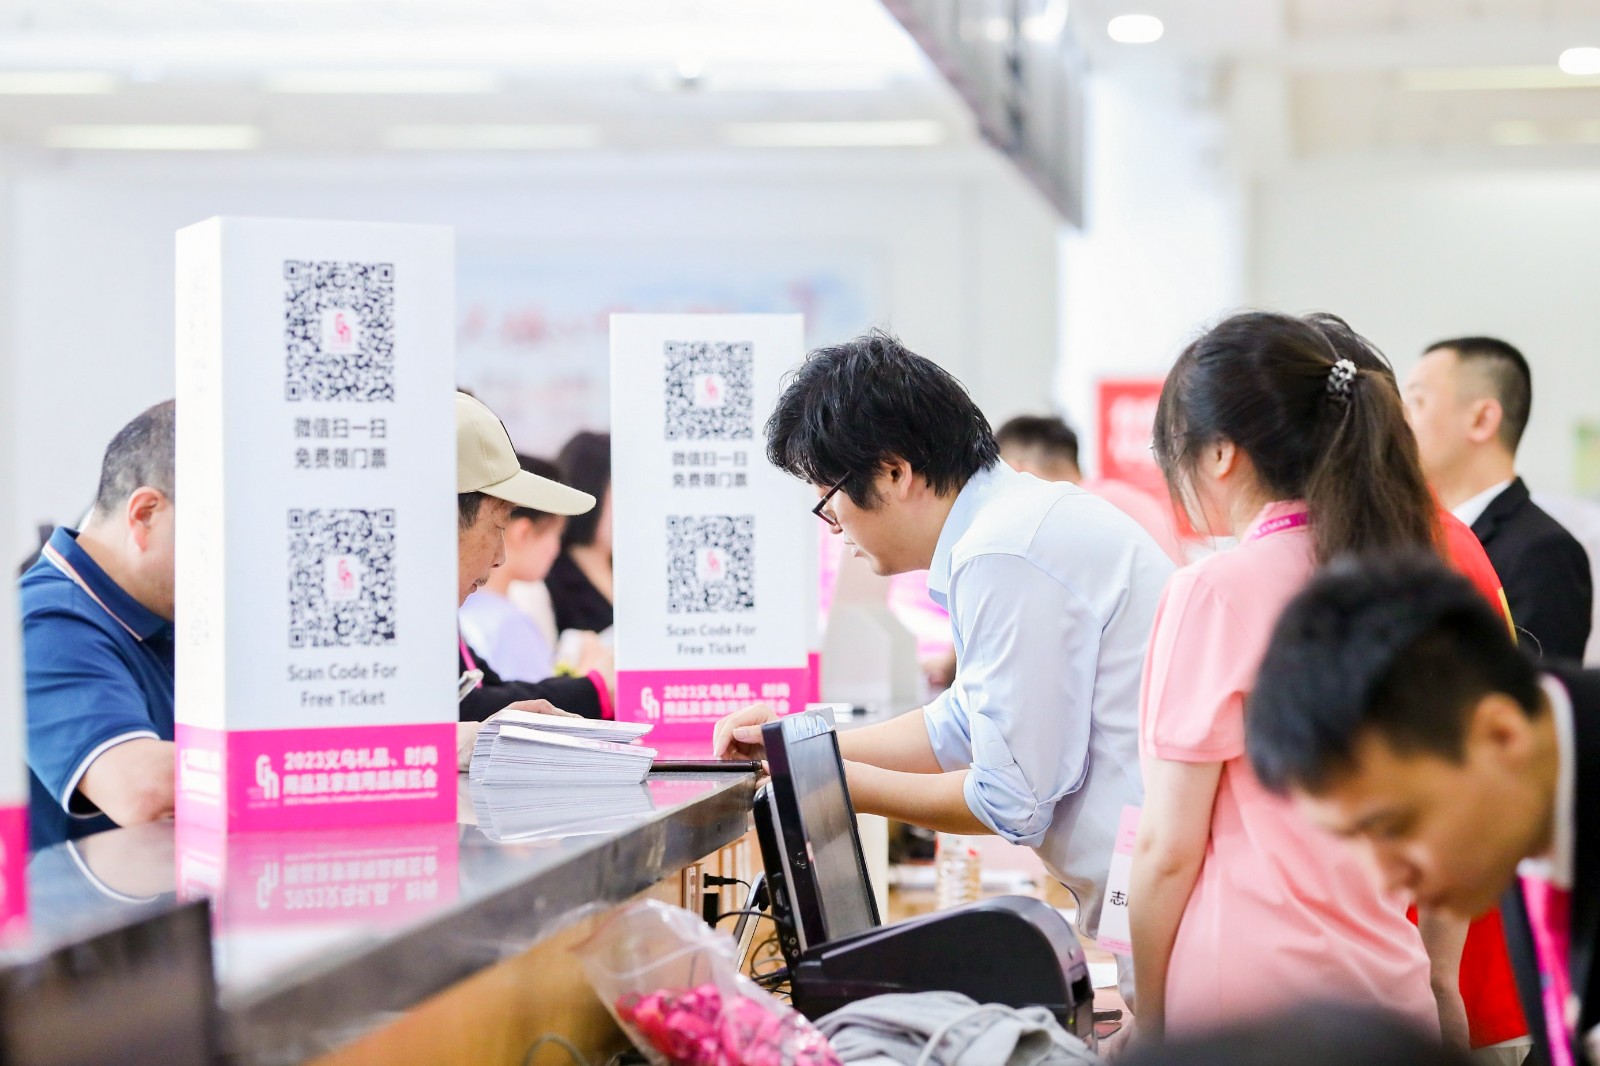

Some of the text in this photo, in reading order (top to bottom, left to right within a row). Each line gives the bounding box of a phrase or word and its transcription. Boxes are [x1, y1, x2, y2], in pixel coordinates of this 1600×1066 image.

[294, 447, 387, 470] 免费领门票
[672, 472, 748, 488] 免费领门票
[665, 622, 757, 638] Scan Code For
[676, 641, 747, 656] Free Ticket
[287, 661, 398, 682] Scan Code For
[300, 688, 386, 708] Free Ticket
